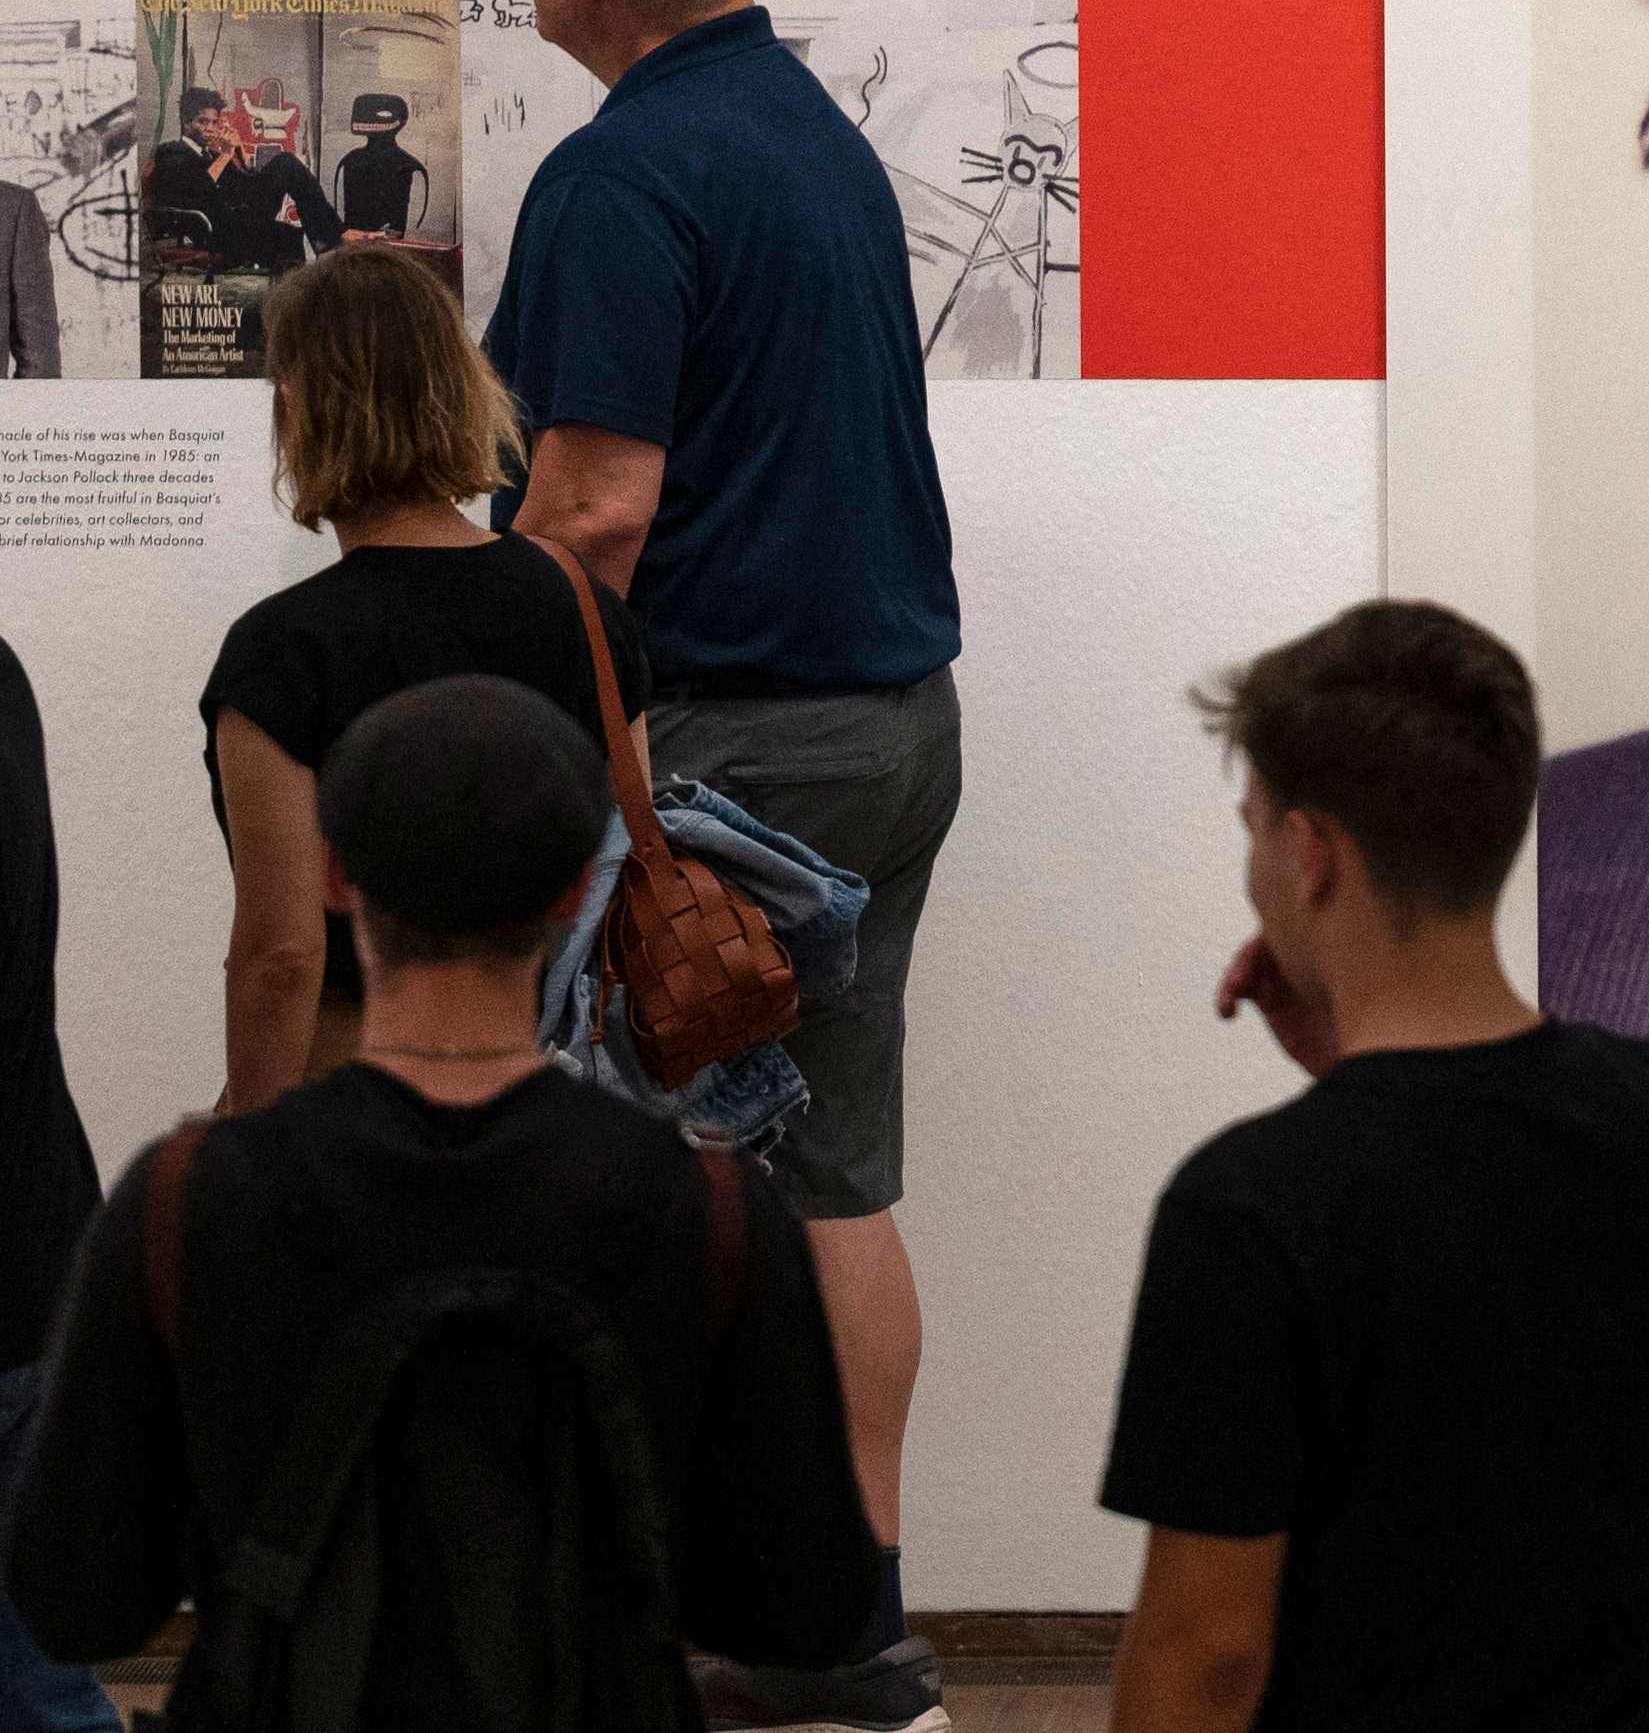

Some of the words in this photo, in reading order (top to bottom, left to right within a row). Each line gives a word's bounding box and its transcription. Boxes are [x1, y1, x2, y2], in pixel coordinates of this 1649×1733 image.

[161, 284, 193, 304] NEW
[194, 284, 222, 306] ART,
[162, 307, 193, 327] NEW
[196, 307, 244, 327] MONEY
[163, 330, 180, 344] The
[181, 329, 225, 347] Marketing
[227, 329, 236, 344] of
[163, 348, 175, 361] An
[220, 348, 244, 361] Artist
[36, 428, 50, 441] of
[53, 428, 70, 441] his
[74, 428, 96, 441] rise
[130, 428, 164, 441] when
[169, 428, 224, 445] Basquiat
[2, 449, 29, 462] York
[33, 449, 141, 465] Times-Magazine
[18, 470, 69, 483] Jackson
[73, 470, 119, 483] Pollock
[123, 470, 155, 483] three
[159, 470, 214, 483] decades
[41, 491, 60, 504] the
[64, 491, 94, 504] most
[98, 491, 137, 504] fruitful
[15, 513, 84, 528] celebrities,
[109, 513, 173, 528] collectors,
[178, 513, 204, 525] and
[31, 533, 106, 550] relationship
[110, 533, 135, 547] with
